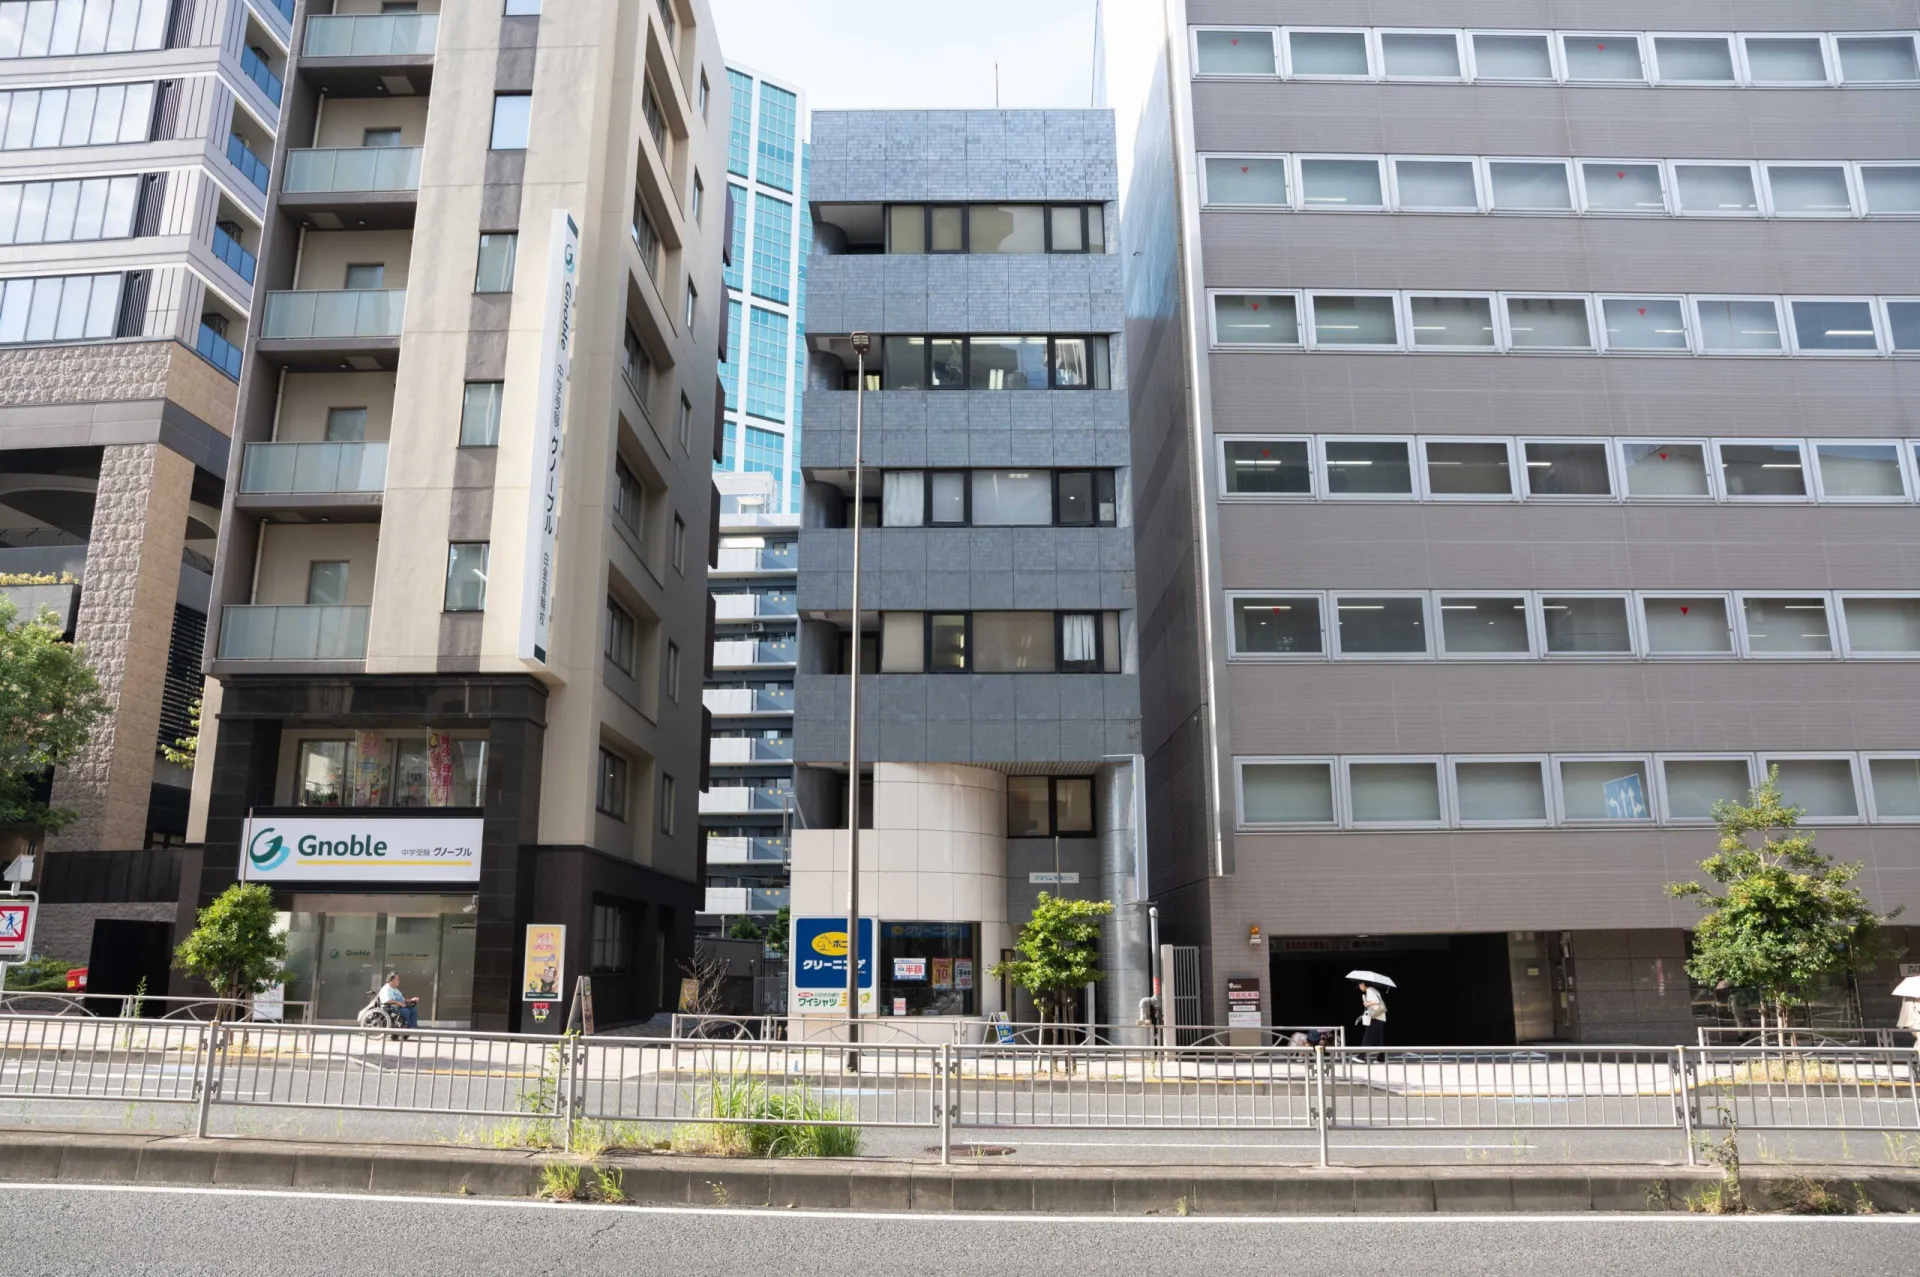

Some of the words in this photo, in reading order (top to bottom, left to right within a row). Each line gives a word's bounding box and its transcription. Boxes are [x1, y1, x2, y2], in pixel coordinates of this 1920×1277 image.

[560, 282, 572, 350] Gnoble
[544, 435, 559, 535] グノーブル
[298, 834, 388, 857] Gnoble
[401, 848, 431, 857] 中学受験
[433, 847, 472, 857] グノーブル
[832, 940, 848, 948] ポニ
[346, 949, 371, 957] Gnoble
[905, 964, 923, 975] 半額
[936, 968, 949, 980] 10
[798, 998, 837, 1006] ワイシャツ
